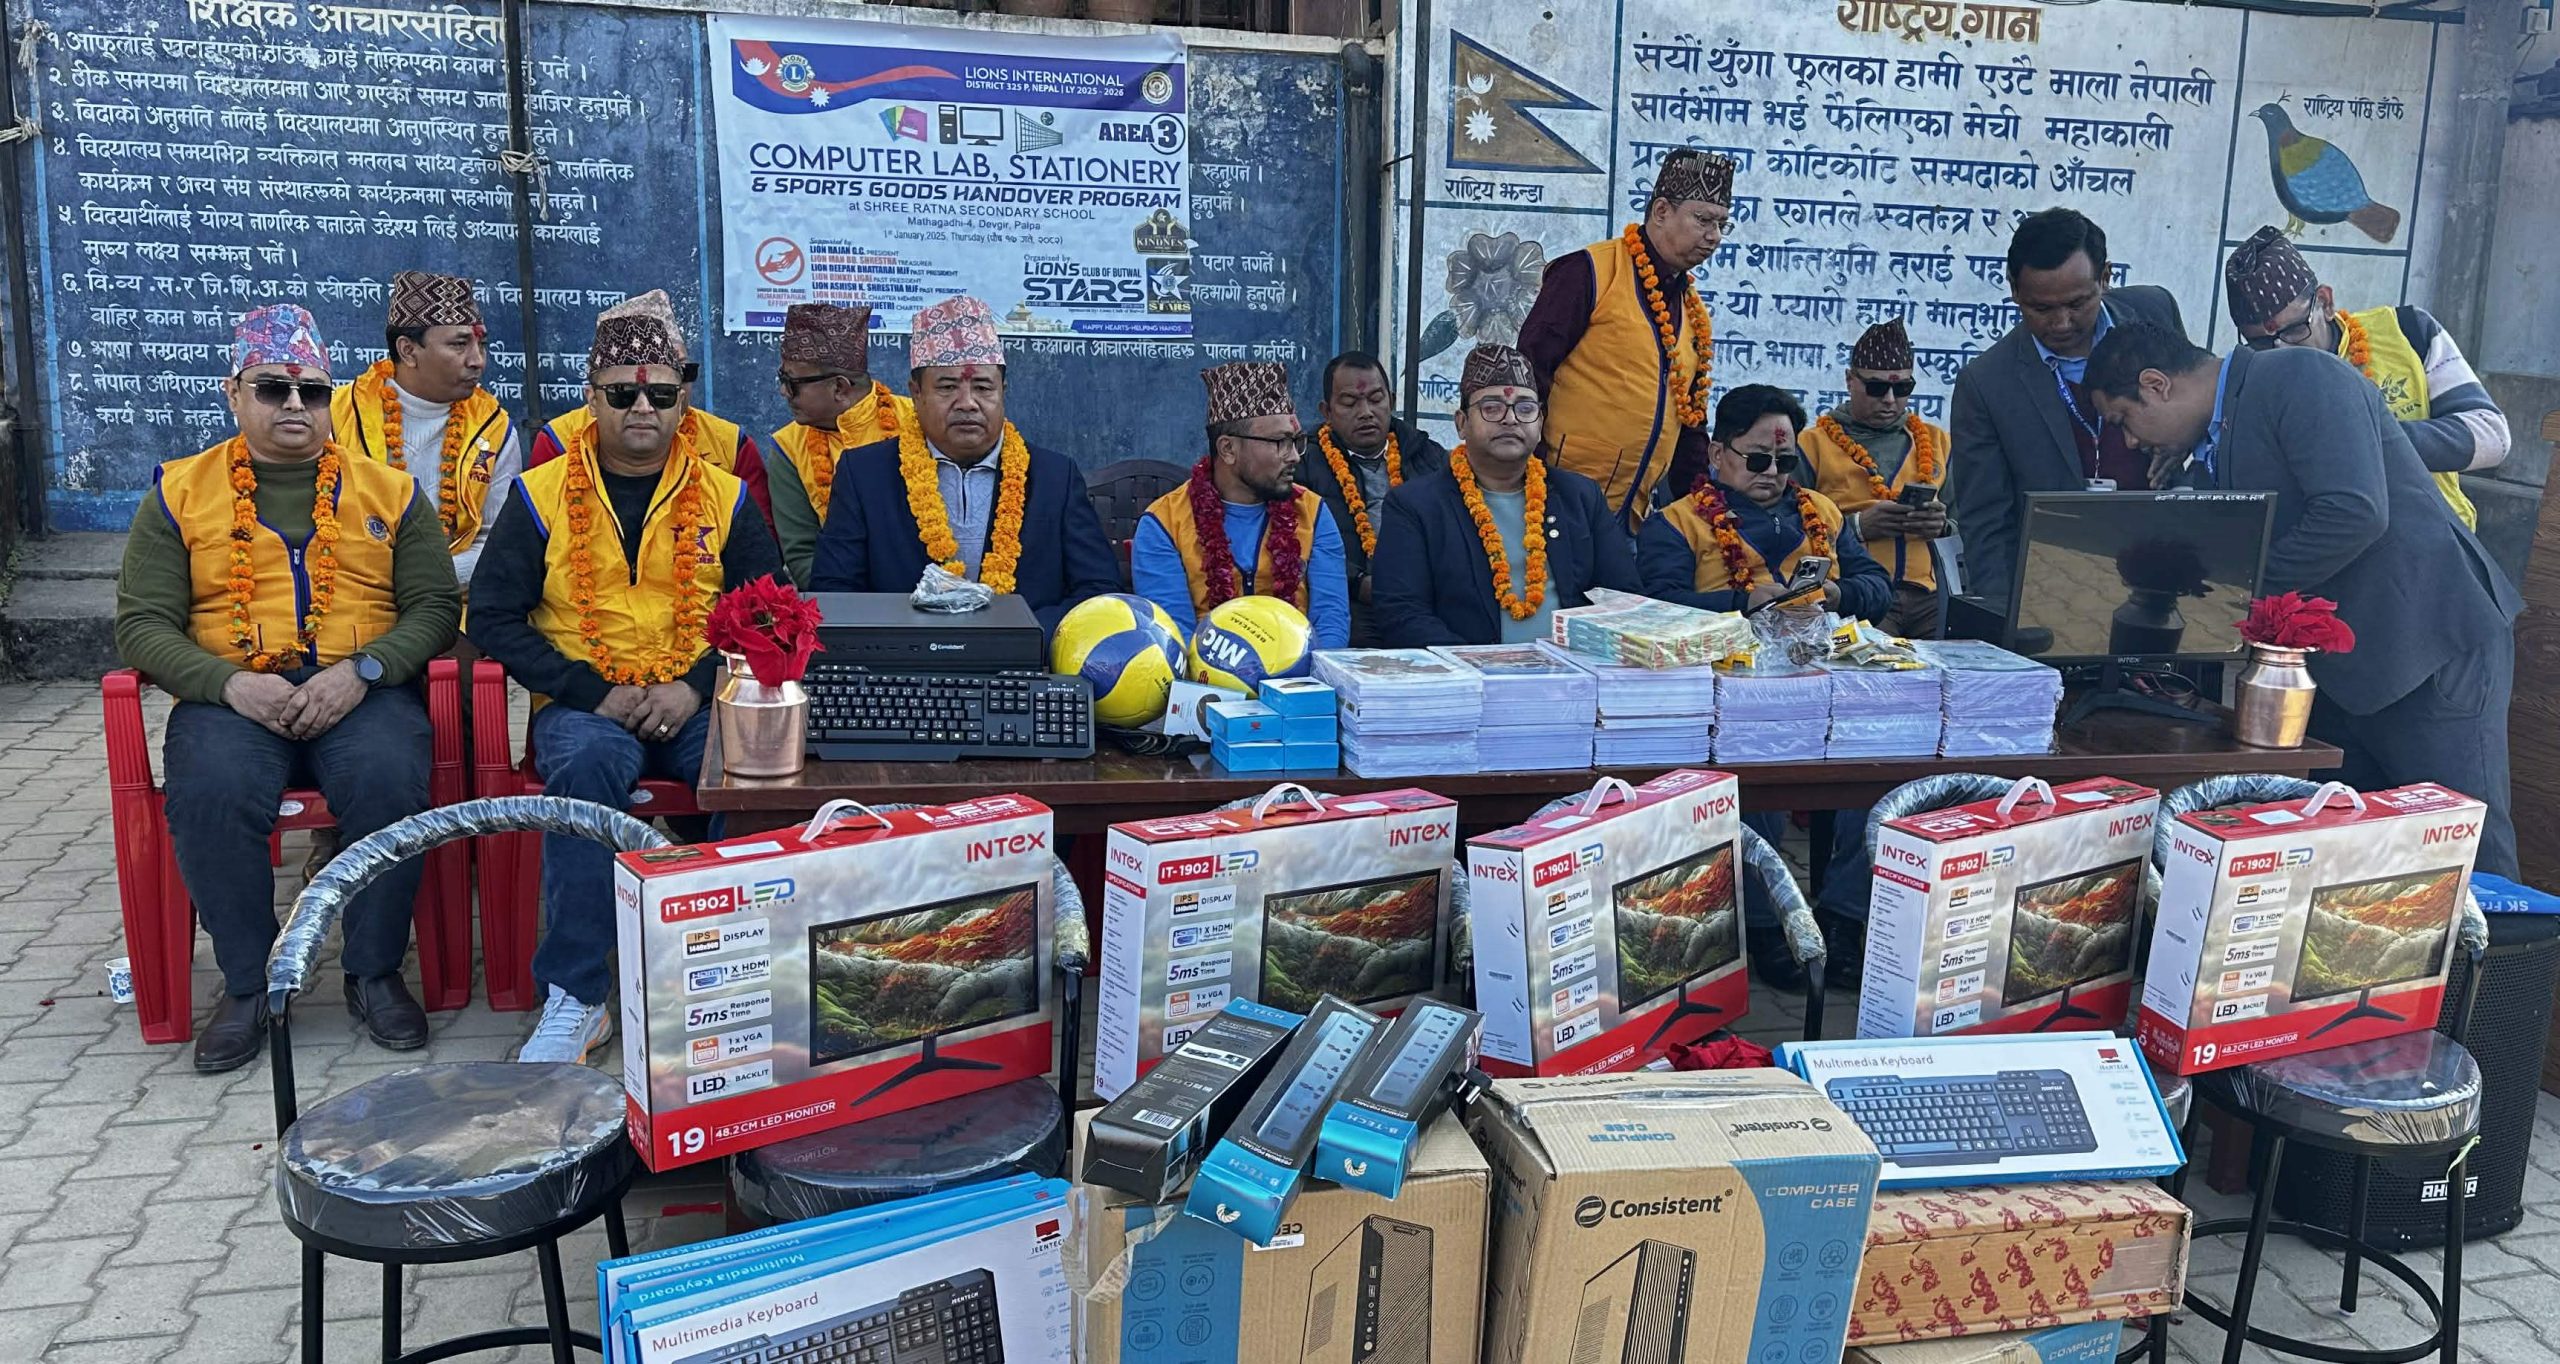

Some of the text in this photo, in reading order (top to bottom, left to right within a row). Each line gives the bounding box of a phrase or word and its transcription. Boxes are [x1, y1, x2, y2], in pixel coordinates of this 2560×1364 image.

[1960, 4, 2040, 43] गान
[452, 56, 496, 77] काम
[965, 66, 1125, 88] LIONS INTERNATIONAL
[71, 60, 467, 108] ठीक समयमा समय
[966, 80, 1124, 97] DISTRICT 325 NEPAL LY 2025 2026
[1784, 52, 1889, 92] फूलका
[1894, 52, 1964, 96] हामी
[1975, 54, 2037, 99] एउटै
[2049, 69, 2122, 104] माला
[2130, 60, 2216, 107] नेपाली
[145, 105, 477, 148] अनुमति अनुपस्थित
[1631, 85, 2174, 153] सार्वभौम भई फैलिएका मेची महाकाली
[1099, 120, 1178, 148] AREA 3
[167, 141, 249, 166] समयभित्र
[256, 145, 338, 171] व्यक्तिगत
[346, 152, 407, 173] मतलब
[413, 153, 456, 175] साध्य
[556, 158, 634, 184] राजनितिक
[750, 143, 1181, 187] COMPUTER LAB, STATIONERY
[1910, 150, 2136, 197] सम्पदाको आँचल
[78, 168, 153, 195] कार्यक्रम
[177, 177, 215, 197] अन्य
[358, 180, 446, 205] कार्यक्रममा
[450, 184, 513, 211] सहभागी
[751, 177, 1181, 209] & SPORTS GOODS HANDOVER PROGRAM
[849, 202, 1095, 220] at SHREE RATNA SECONDARY SCHOOL
[1773, 189, 1861, 234] रगतले
[1873, 202, 1974, 238] स्वतन्त्र
[1982, 208, 2000, 238] र
[197, 207, 458, 241] योग्य नागरिक बनाउने लिई
[1015, 220, 1040, 232] Palpa
[951, 232, 985, 242] Thursday
[136, 240, 179, 262] लक्ष्य
[1024, 261, 1142, 278] LIONS CLUB BUTWAL
[1889, 244, 1955, 291] तराई
[1023, 278, 1145, 303] STARS
[1727, 280, 1847, 328] यो प्यारो
[144, 308, 184, 328] काम
[90, 341, 133, 361] भाषा
[1202, 344, 1248, 362] पालना
[92, 364, 141, 393] नेपाल
[95, 399, 173, 427] कार्य गर्न
[1161, 850, 1259, 881] IT-1902 LED
[1536, 843, 1604, 883] IT-1902 LED
[1943, 846, 2015, 876] IT-1902 LED
[2231, 847, 2313, 873] IT-1902 LED
[665, 878, 795, 918] IT-1902 LED
[1201, 895, 1232, 906] DISPLAY
[694, 929, 764, 943] IPS DISPLAY
[1212, 922, 1232, 933] HDMI
[742, 960, 769, 972] HDMI
[1941, 954, 1963, 968] 5ms
[2225, 948, 2251, 962] 5ms
[1168, 965, 1198, 981] 5ms
[1552, 962, 1573, 980] 5ms
[1208, 989, 1223, 999] VGA
[688, 1008, 751, 1027] 5ms Time
[743, 1032, 763, 1044] VGA
[1557, 1026, 1575, 1044] LED
[729, 1045, 748, 1056] Port
[1813, 1053, 1933, 1070] Multimedia Keyboard
[2193, 1043, 2217, 1067] 19
[692, 1068, 769, 1096] LED BACKLIT
[668, 1101, 836, 1158] 19 48.2CM LED MONITOR
[1589, 1132, 1677, 1143] COMPUTER
[1735, 1119, 1810, 1135] Consistent
[1765, 1182, 1860, 1198] COMPUTER
[1811, 1196, 1858, 1210] CASE
[638, 1252, 806, 1304] Multimedia Keyboard
[652, 1291, 820, 1352] Multimedia Keyboard
[2048, 1332, 2114, 1361] COMPUTER
[2080, 1344, 2111, 1361] CASE
